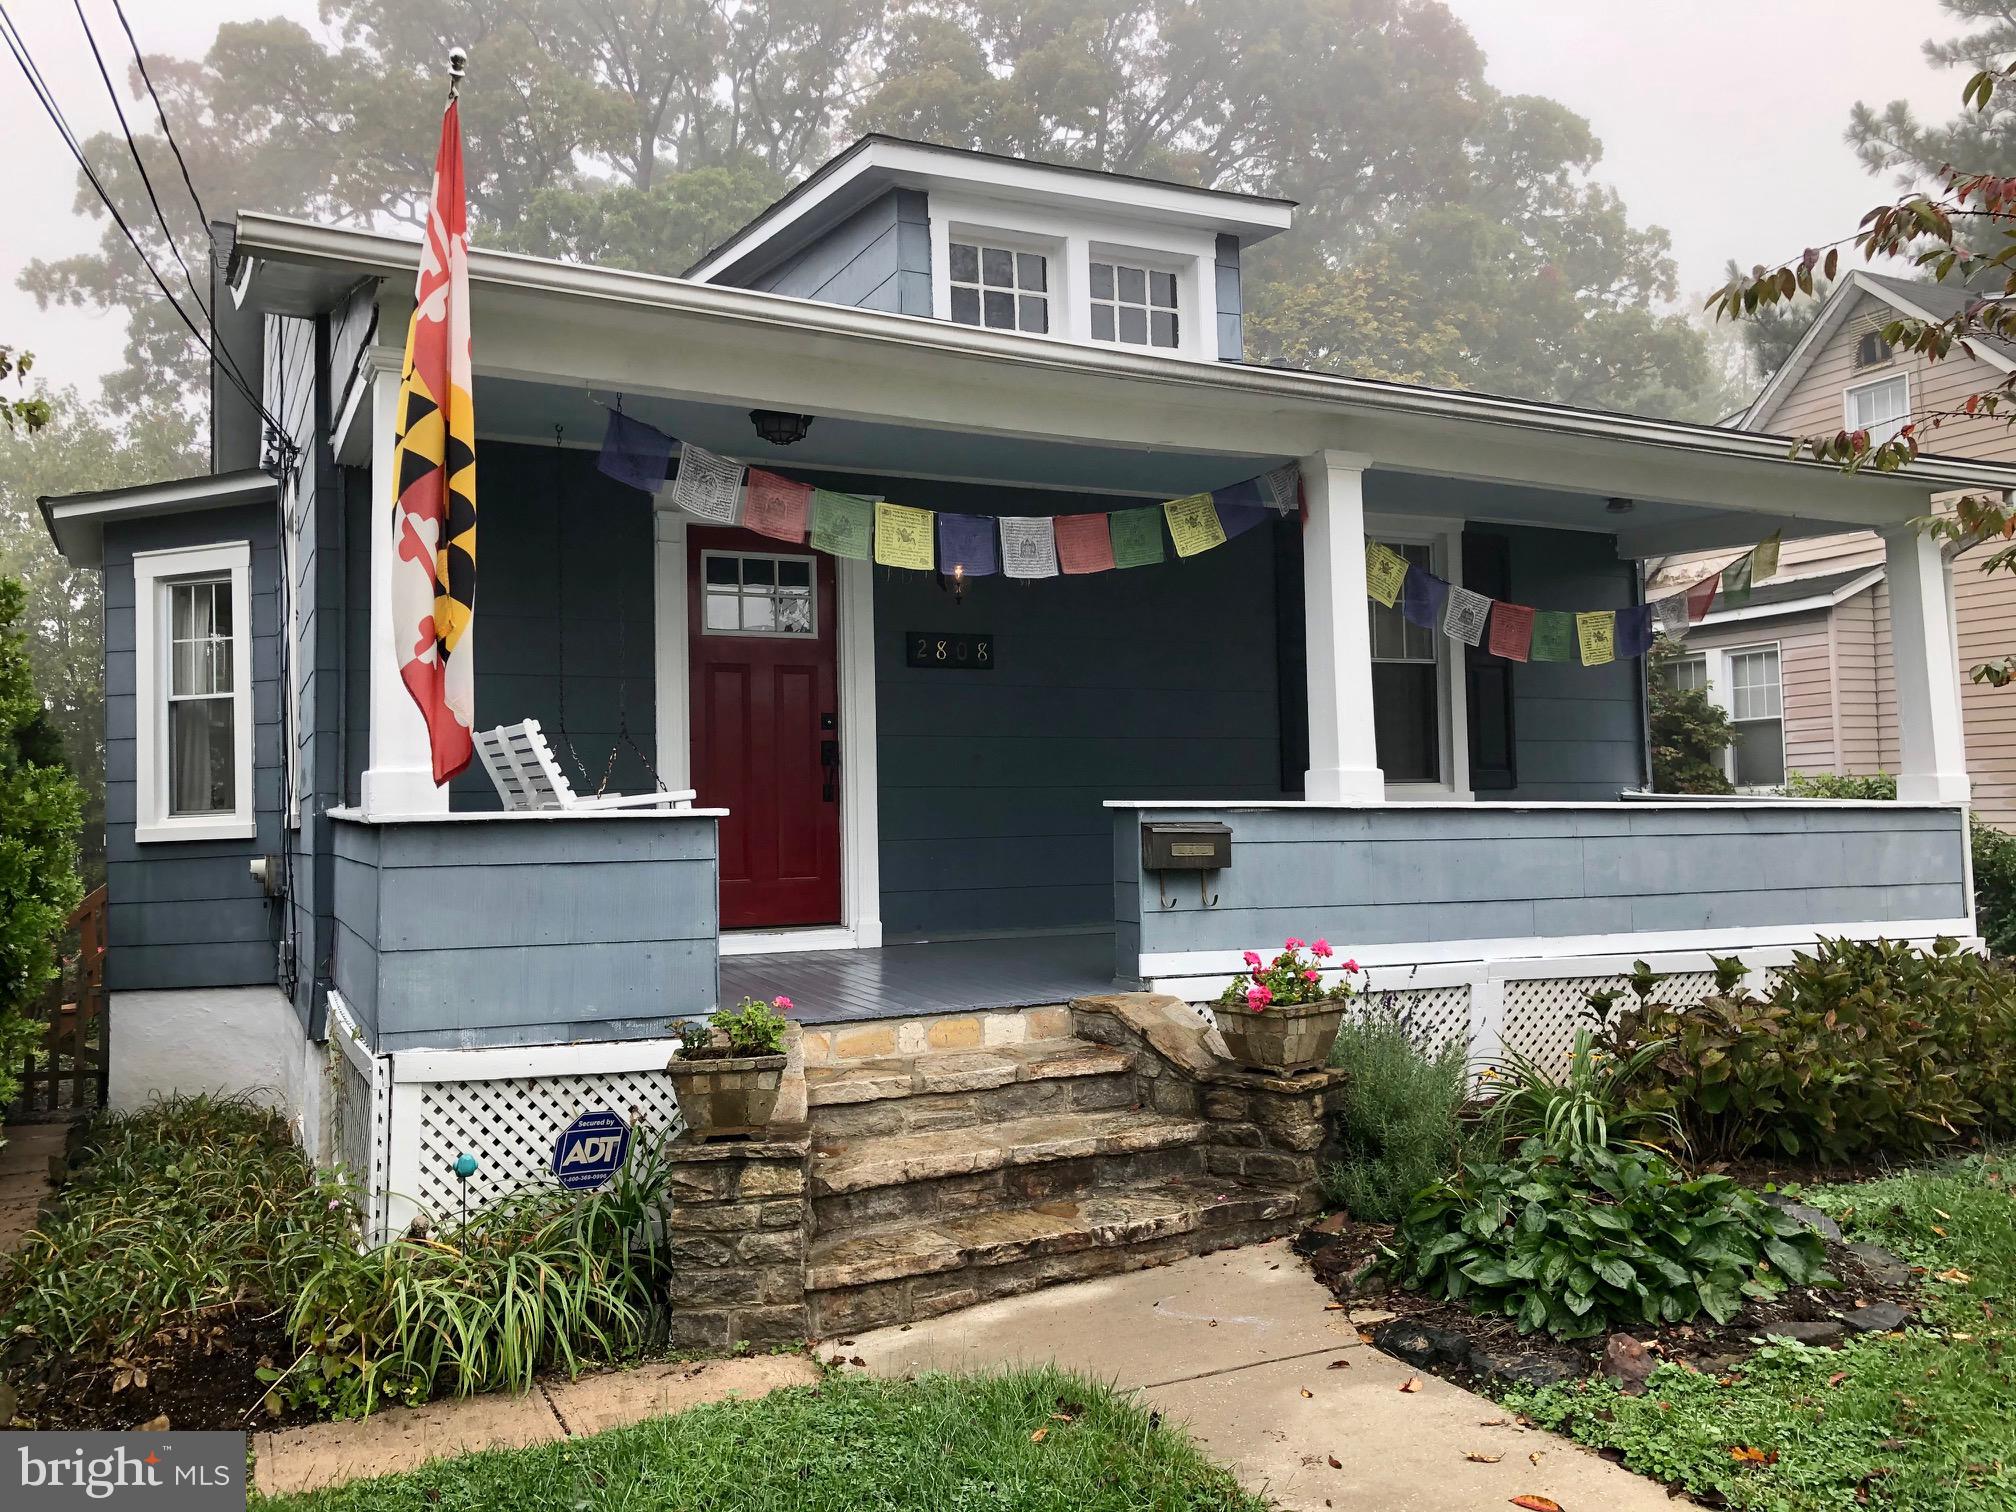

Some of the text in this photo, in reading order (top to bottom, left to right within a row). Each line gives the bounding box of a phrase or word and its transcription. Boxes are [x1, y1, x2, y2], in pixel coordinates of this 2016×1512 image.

[917, 639, 988, 662] 2808
[578, 1118, 615, 1127] Secured by
[562, 1136, 621, 1167] ADT
